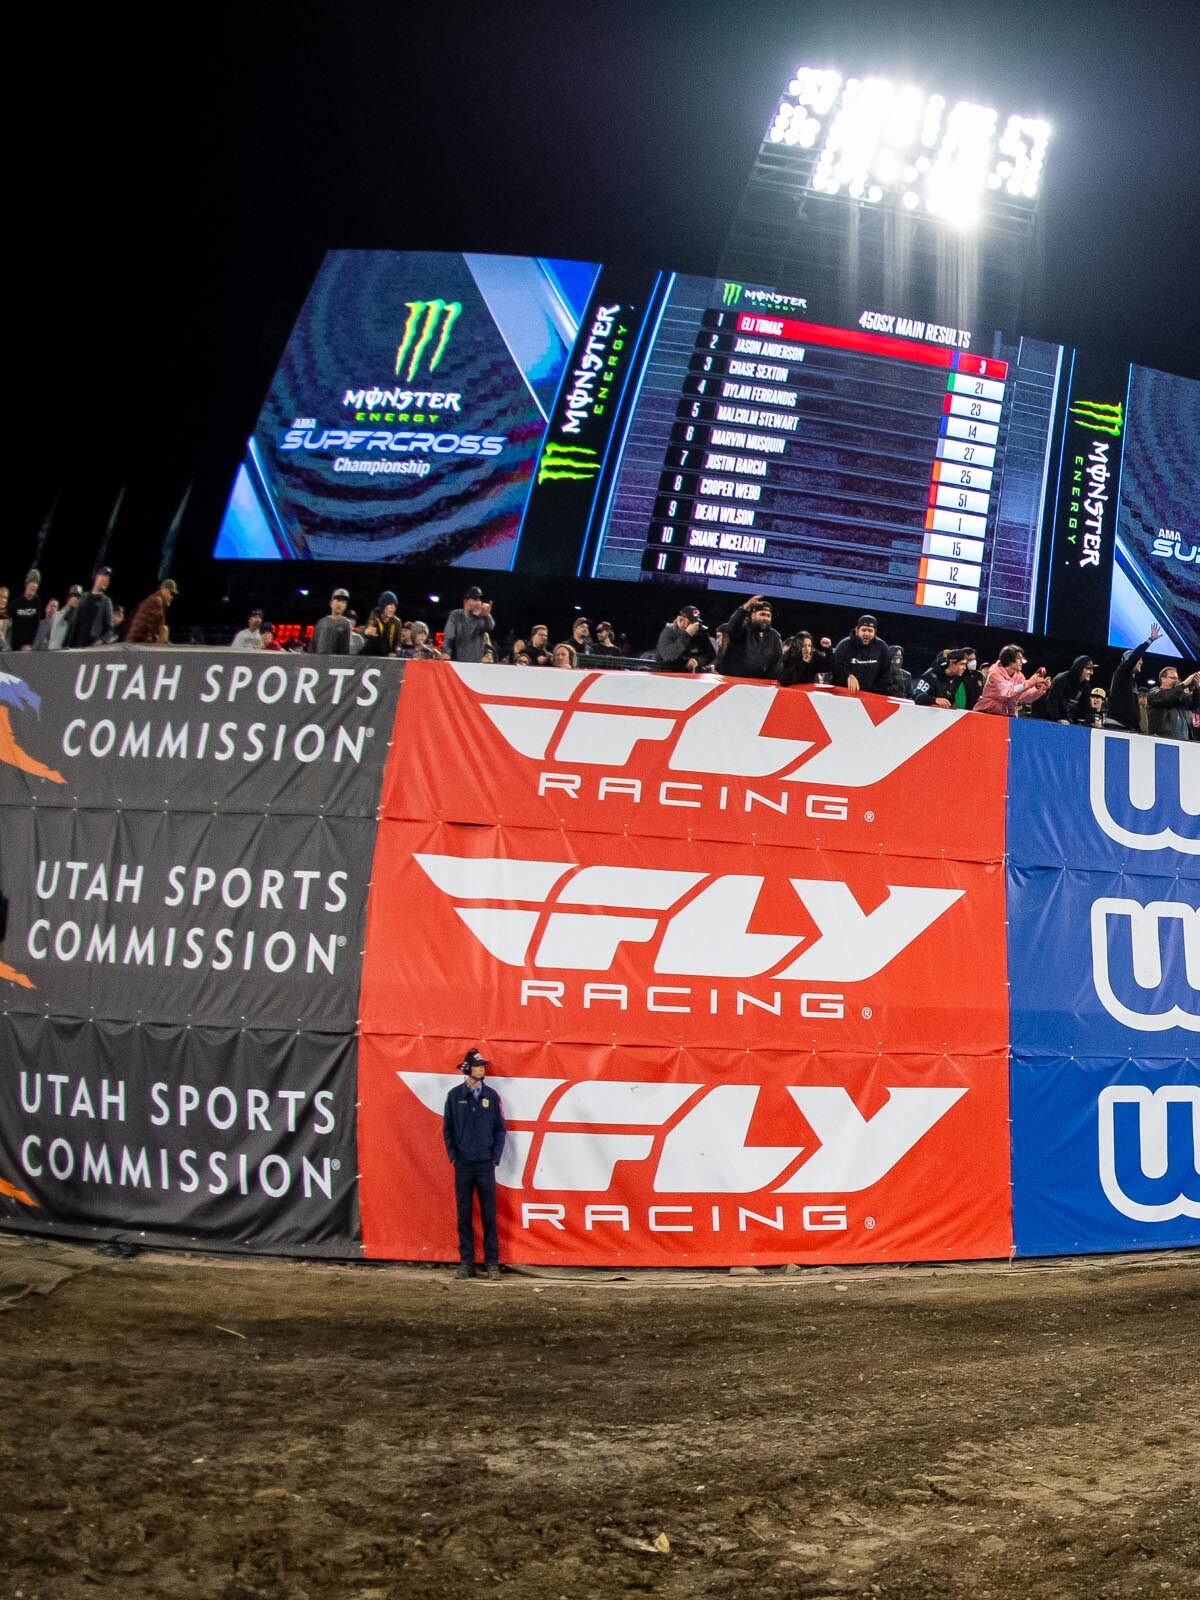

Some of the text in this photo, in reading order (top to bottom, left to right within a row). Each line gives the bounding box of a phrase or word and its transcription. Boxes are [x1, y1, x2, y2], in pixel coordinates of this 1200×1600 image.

[717, 313, 724, 327] 1
[741, 317, 755, 331] ELI
[979, 360, 987, 375] 3
[858, 311, 971, 349] 450SX MAIN RESULTS
[561, 303, 620, 434] MONSTER
[593, 325, 628, 416] ENERGY
[703, 356, 981, 417] 3 CHASE SEXTON 23
[709, 334, 984, 394] 2 JASON ANDERSON 21
[343, 387, 462, 412] MONSTER
[356, 412, 440, 424] ENERGY
[697, 379, 977, 438] 4 DYLAN FERRANDIS 14
[280, 430, 508, 456] SUPERCROSS
[685, 426, 971, 484] 6 MARVIN MUSQUIN 25
[691, 402, 975, 461] 5 MALCOLM STEWART 27
[333, 457, 430, 477] Championship
[680, 450, 967, 508] 7 JUSTIN BARCIA 51
[668, 501, 961, 557] 9 DEAN WILSON 15
[673, 475, 962, 532] 8 COOPER WEBB 1
[1067, 455, 1084, 545] ENERGY
[1079, 441, 1110, 568] MONSTER
[661, 526, 958, 581] 10 SHANE MCELRATH 12
[1158, 528, 1181, 542] AMA
[657, 553, 957, 607] 11 MAX ANSTIE 34
[74, 663, 382, 707] UTAH SPORTS
[449, 661, 969, 788] FLY
[36, 860, 349, 913] UTAH SPORTS
[413, 853, 968, 983] FLY
[20, 1070, 337, 1135] UTAH SPORTS
[396, 1071, 970, 1194] FLY
